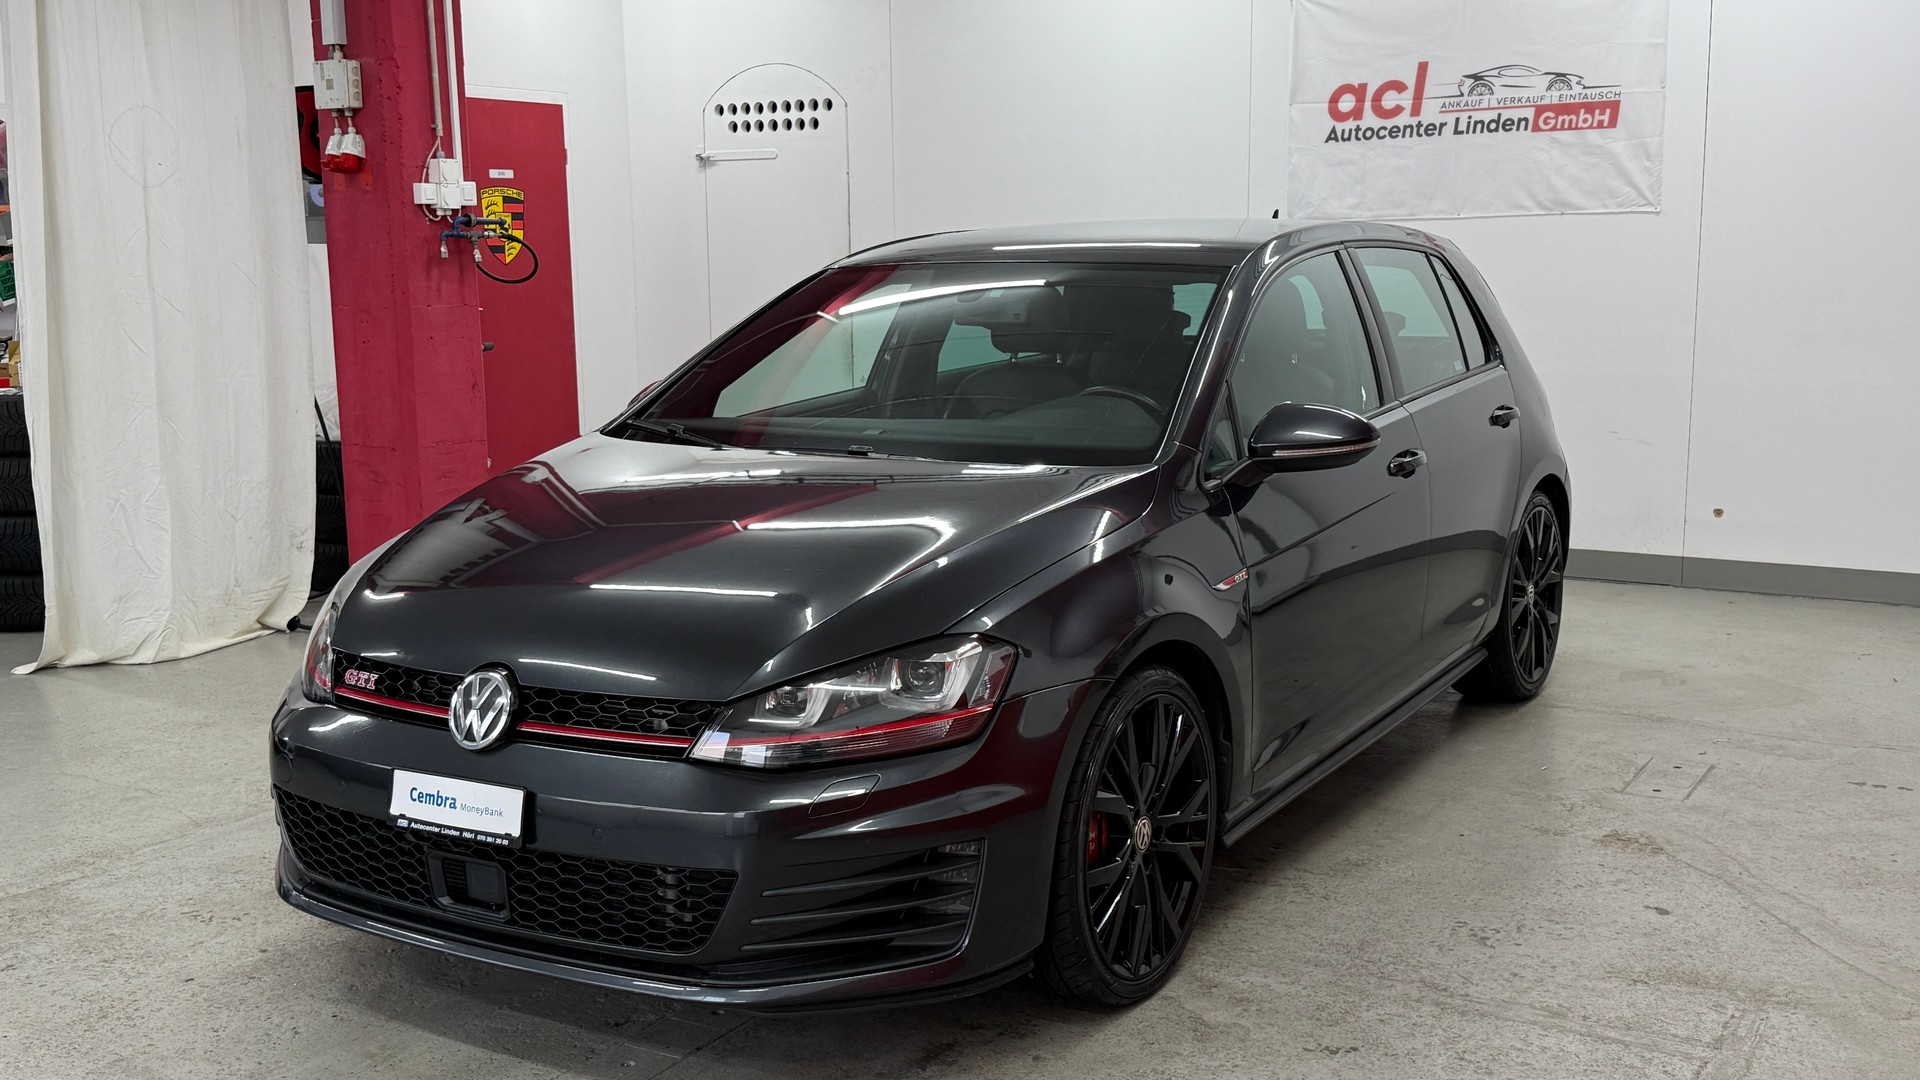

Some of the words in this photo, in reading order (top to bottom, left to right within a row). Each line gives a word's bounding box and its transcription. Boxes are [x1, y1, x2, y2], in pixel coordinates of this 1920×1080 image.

[1327, 61, 1429, 123] acl
[1440, 98, 1484, 110] ANKAUF
[1496, 94, 1546, 106] VERKAUF
[1558, 90, 1622, 102] EINTAUSCH
[1324, 119, 1447, 143] Autocenter
[1453, 113, 1529, 136] Linden
[1538, 108, 1610, 130] GmbH
[481, 188, 523, 199] PORSCHE
[344, 668, 379, 690] GTI
[409, 787, 457, 810] Cembra
[460, 803, 504, 818] MoneyBank
[410, 821, 441, 833] Autocenter
[441, 827, 460, 837] Linden
